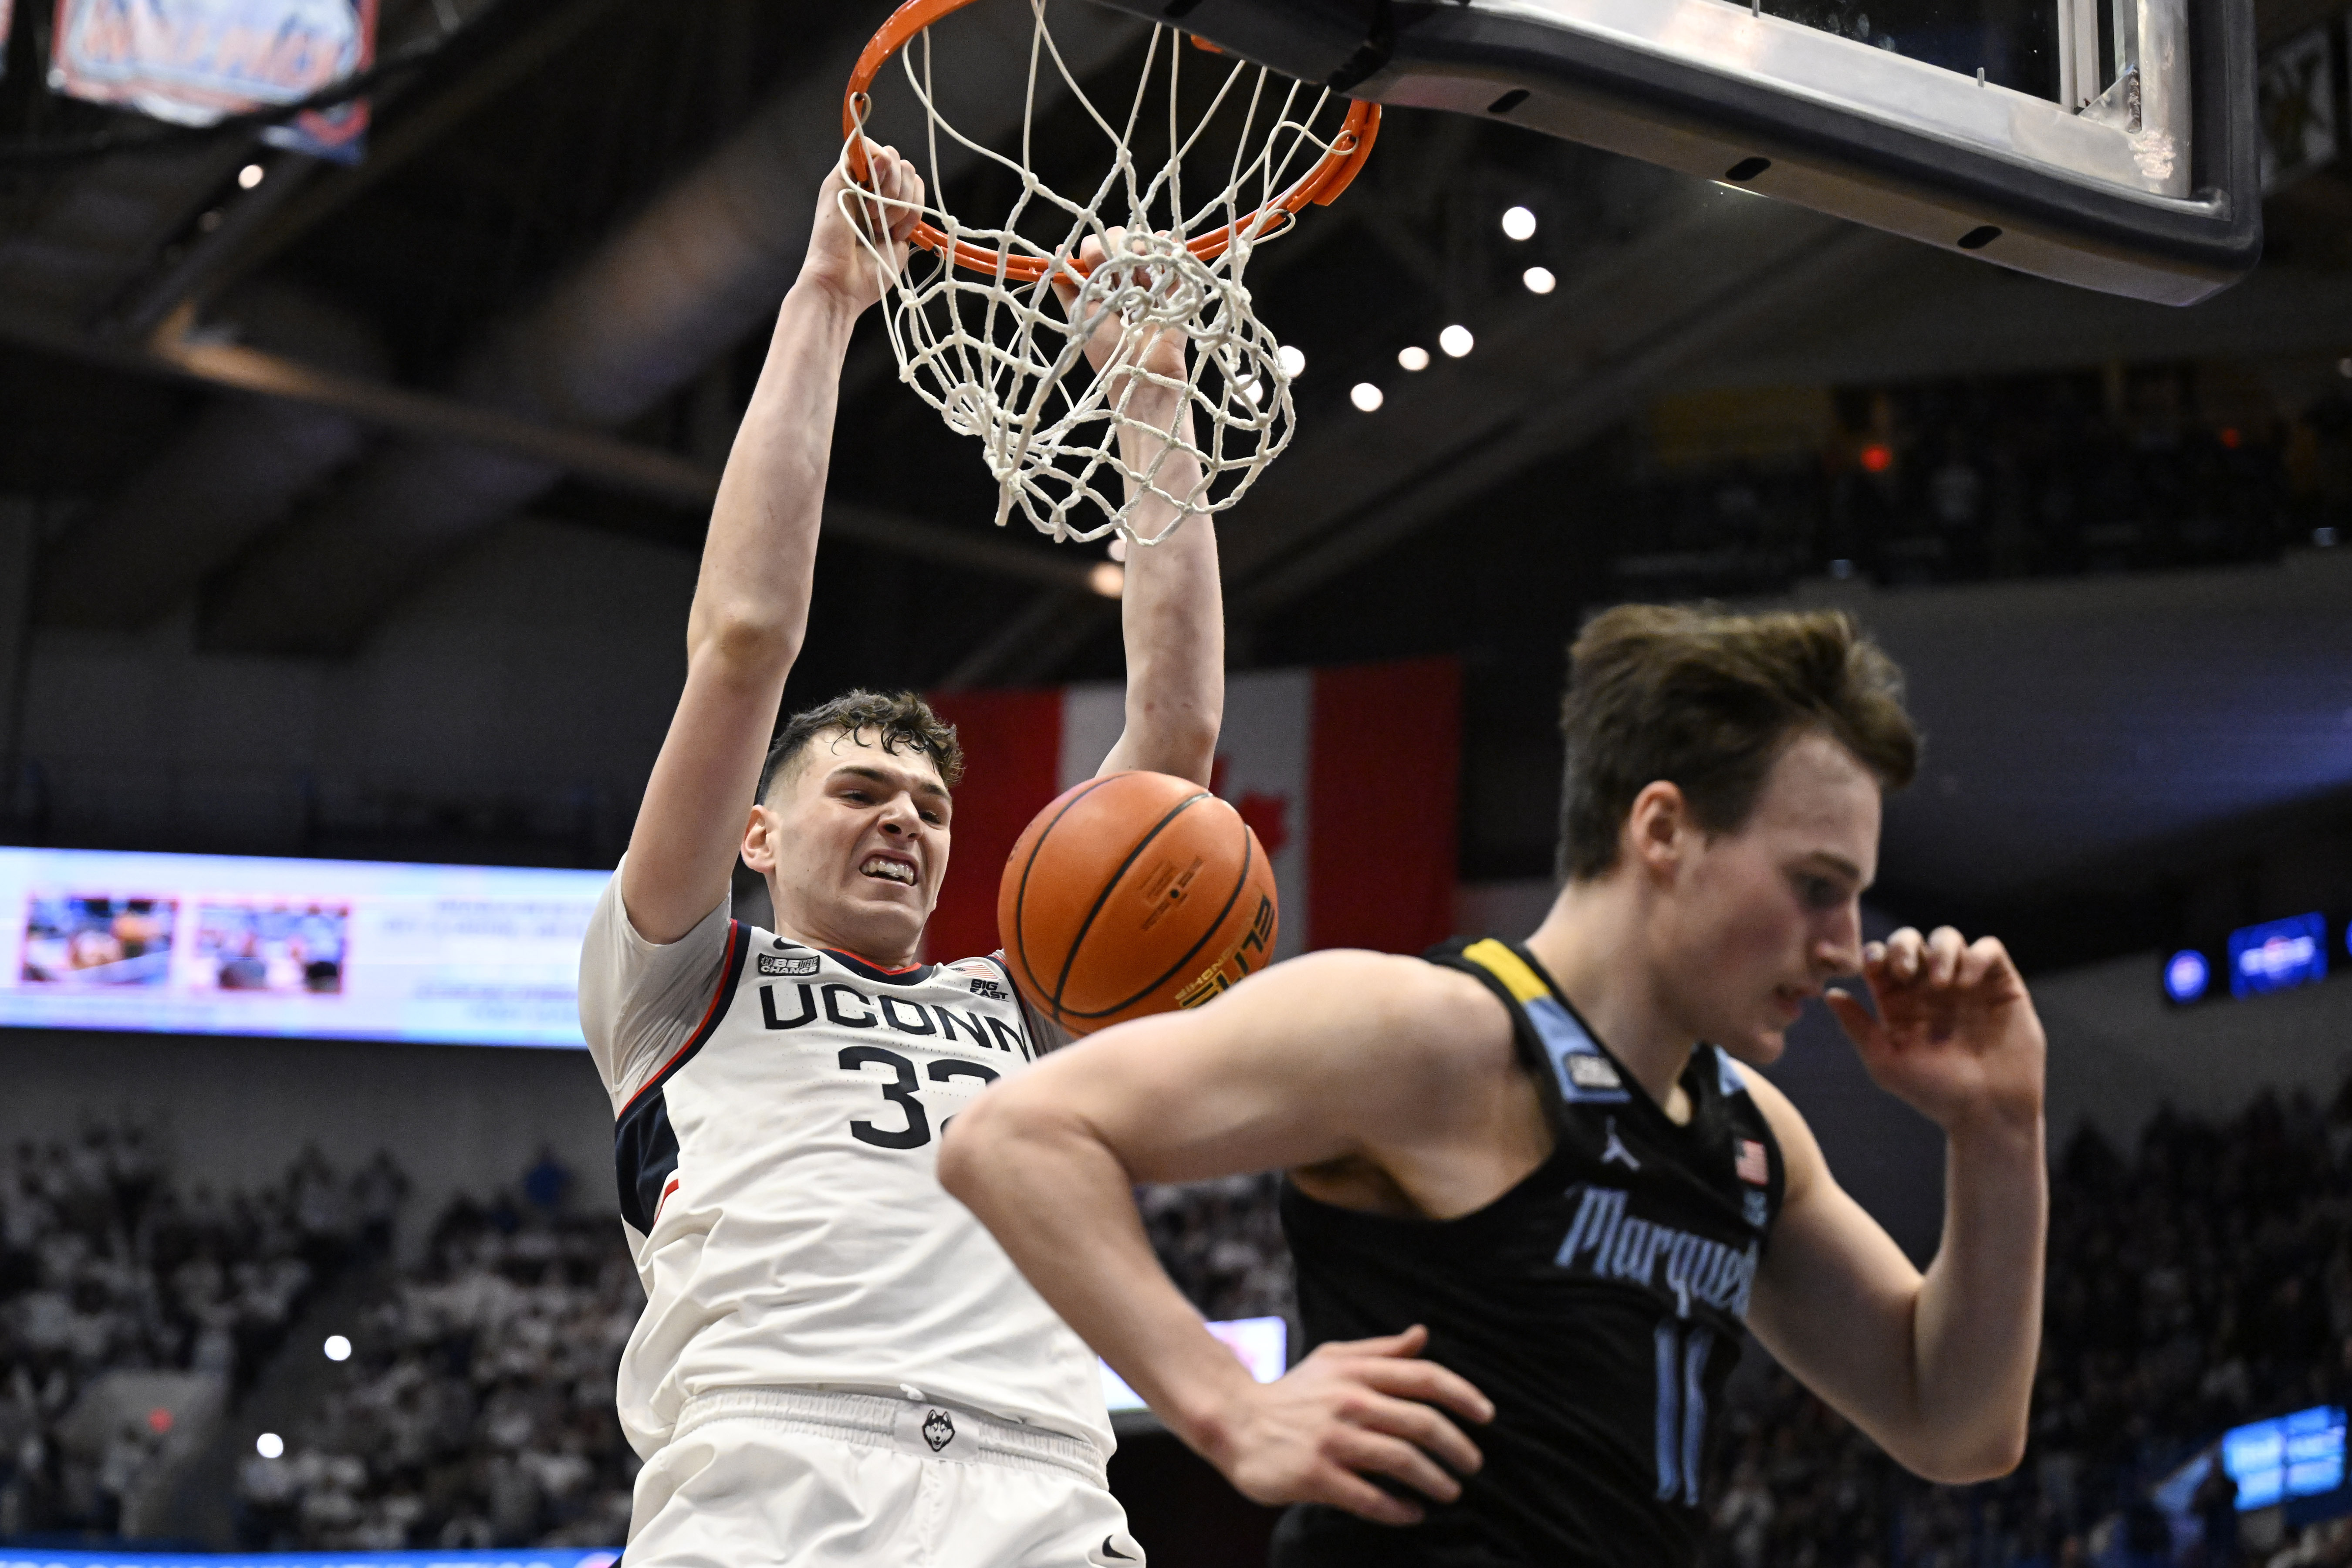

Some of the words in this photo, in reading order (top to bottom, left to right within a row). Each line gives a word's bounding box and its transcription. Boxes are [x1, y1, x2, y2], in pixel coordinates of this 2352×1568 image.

[760, 965, 818, 974] CHANGE
[971, 979, 999, 990] BIG
[970, 987, 1008, 999] EAST
[760, 983, 1031, 1064] UCONN
[1655, 1321, 1714, 1508] 11
